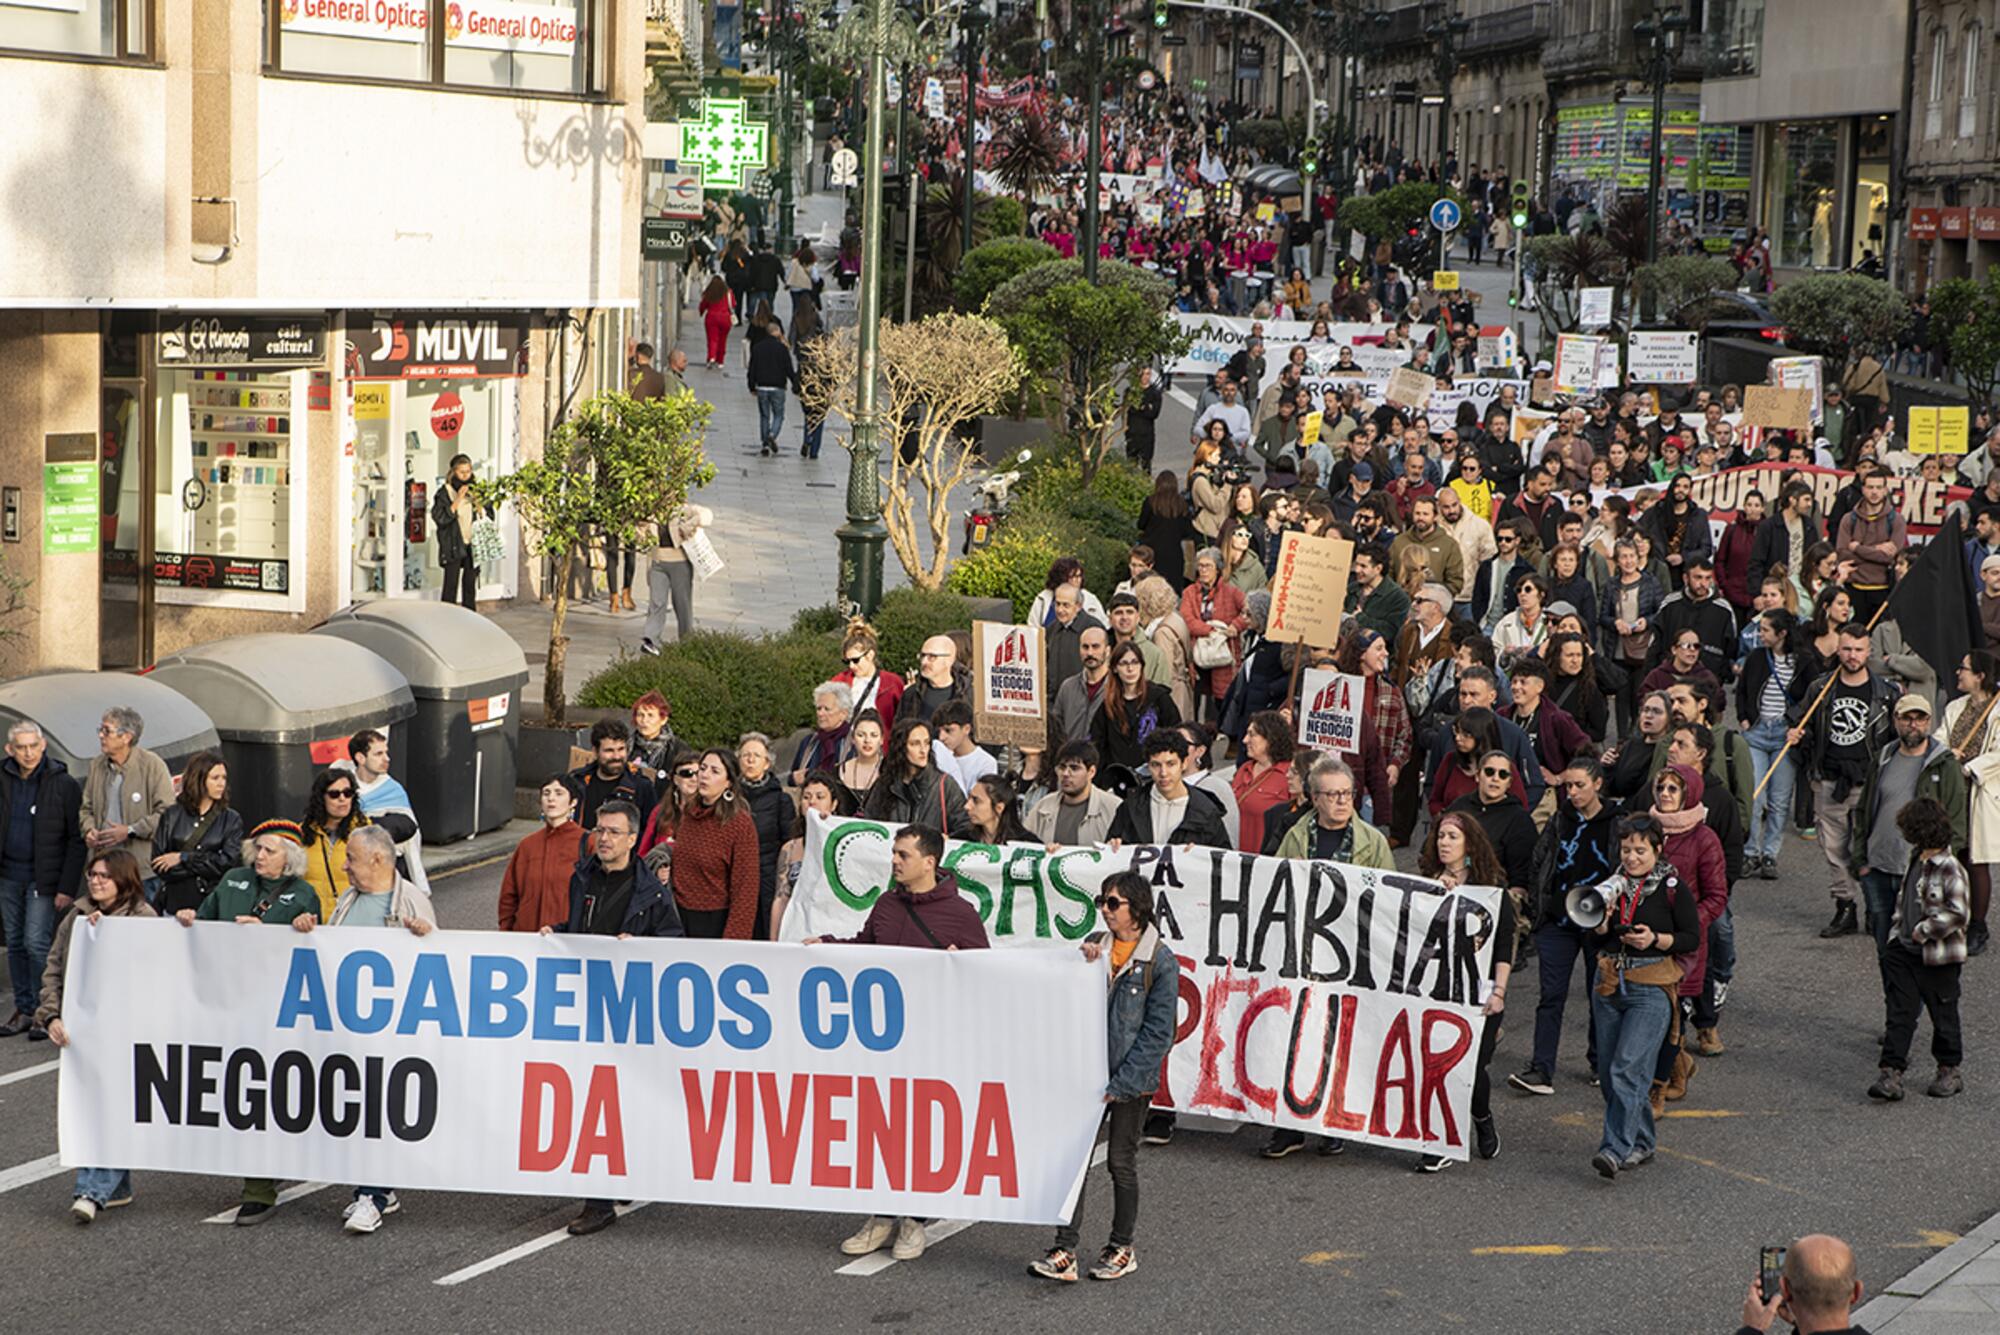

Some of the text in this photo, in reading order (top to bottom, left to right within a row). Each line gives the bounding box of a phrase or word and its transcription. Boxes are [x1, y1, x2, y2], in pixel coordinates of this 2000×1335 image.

[303, 0, 428, 32] General Optica
[468, 11, 577, 47] General Optica
[208, 317, 250, 350] Rincón
[265, 338, 314, 354] cultural
[991, 675, 1033, 692] NEGOCIO
[991, 688, 1034, 702] DA VIVENDA
[1305, 733, 1352, 748] DA VIVENDA
[1306, 719, 1354, 739] NEGOCIO
[823, 821, 1102, 940] CSAS
[276, 946, 905, 1052] ACABEMOS CO
[133, 1043, 1019, 1199] NEGOCIO DA VIVENDA
